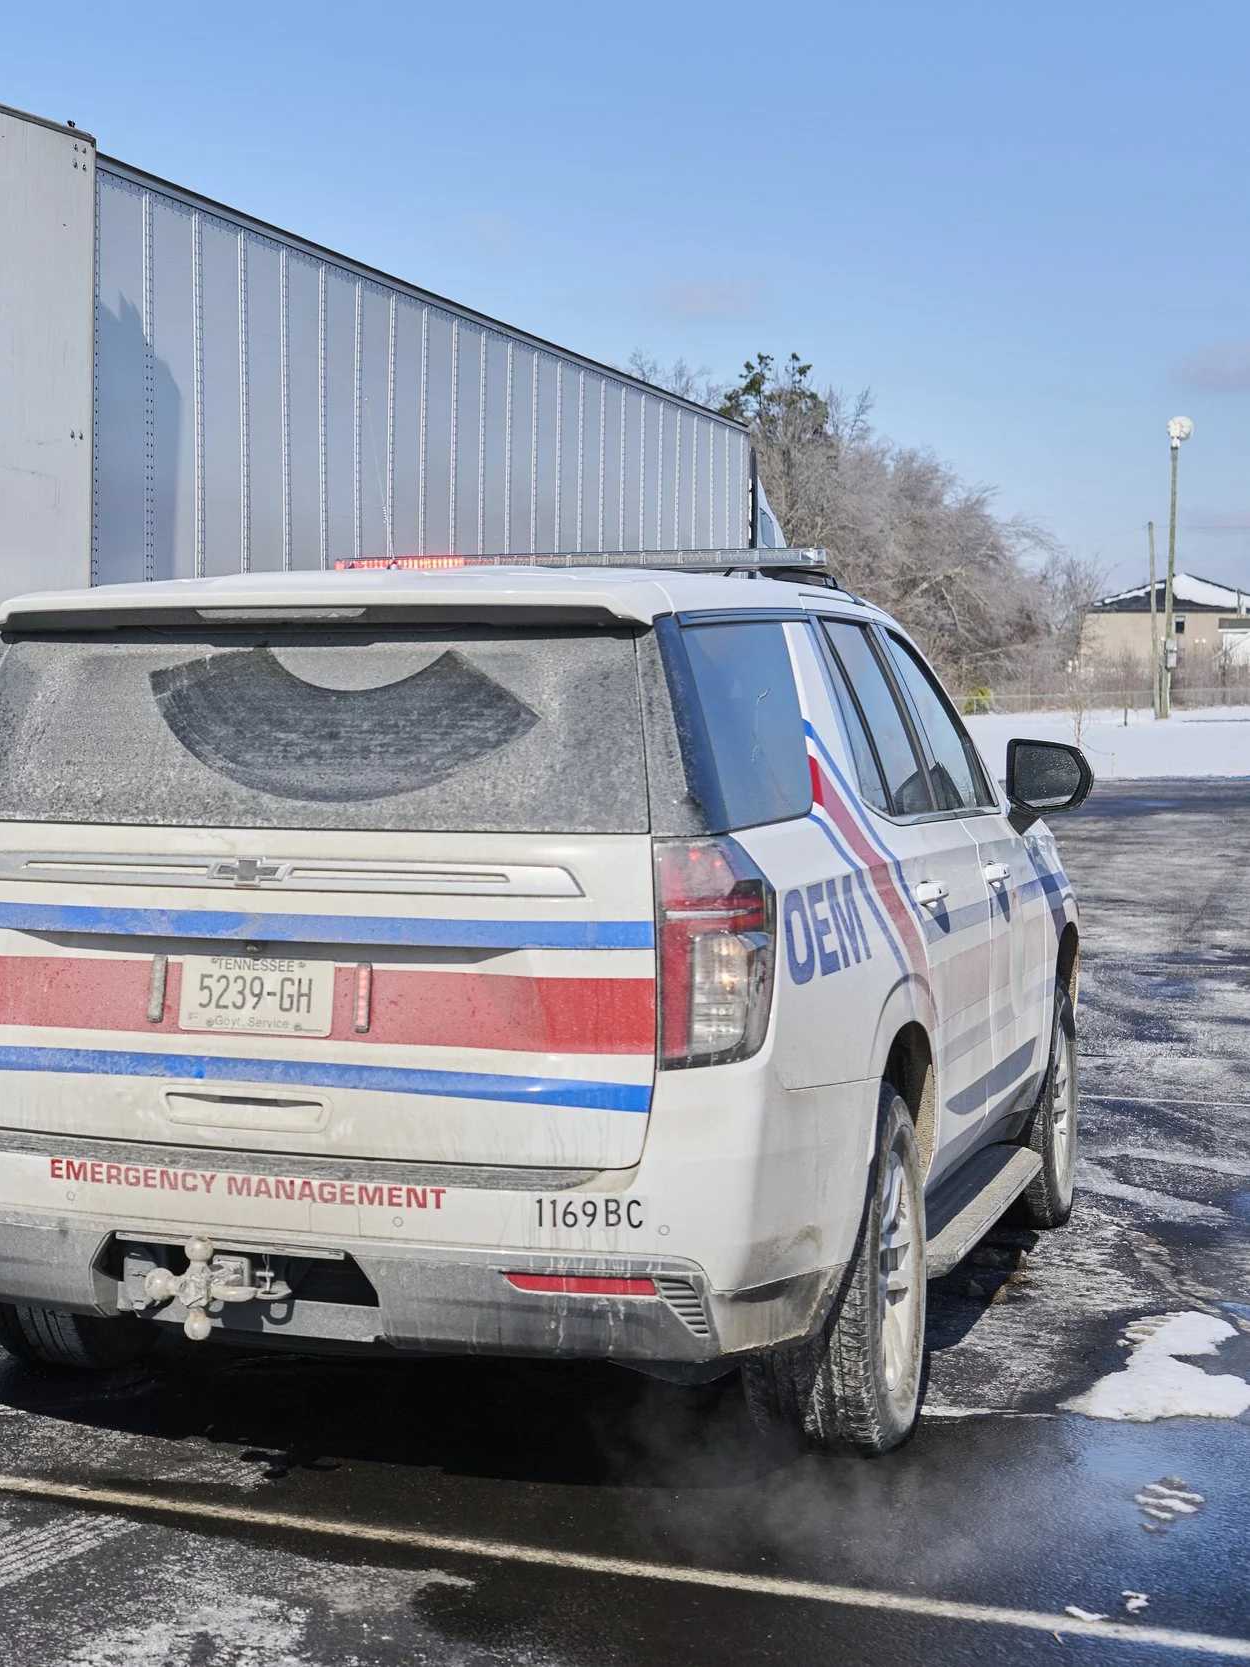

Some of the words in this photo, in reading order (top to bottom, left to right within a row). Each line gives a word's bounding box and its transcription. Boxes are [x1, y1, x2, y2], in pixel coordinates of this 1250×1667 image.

[783, 874, 872, 986] OEM
[217, 958, 295, 973] TENNESSEE
[198, 973, 313, 1014] 5239-GH
[247, 1016, 290, 1030] Service
[50, 1158, 218, 1194] EMERGENCY
[226, 1175, 447, 1211] MANAGEMENT
